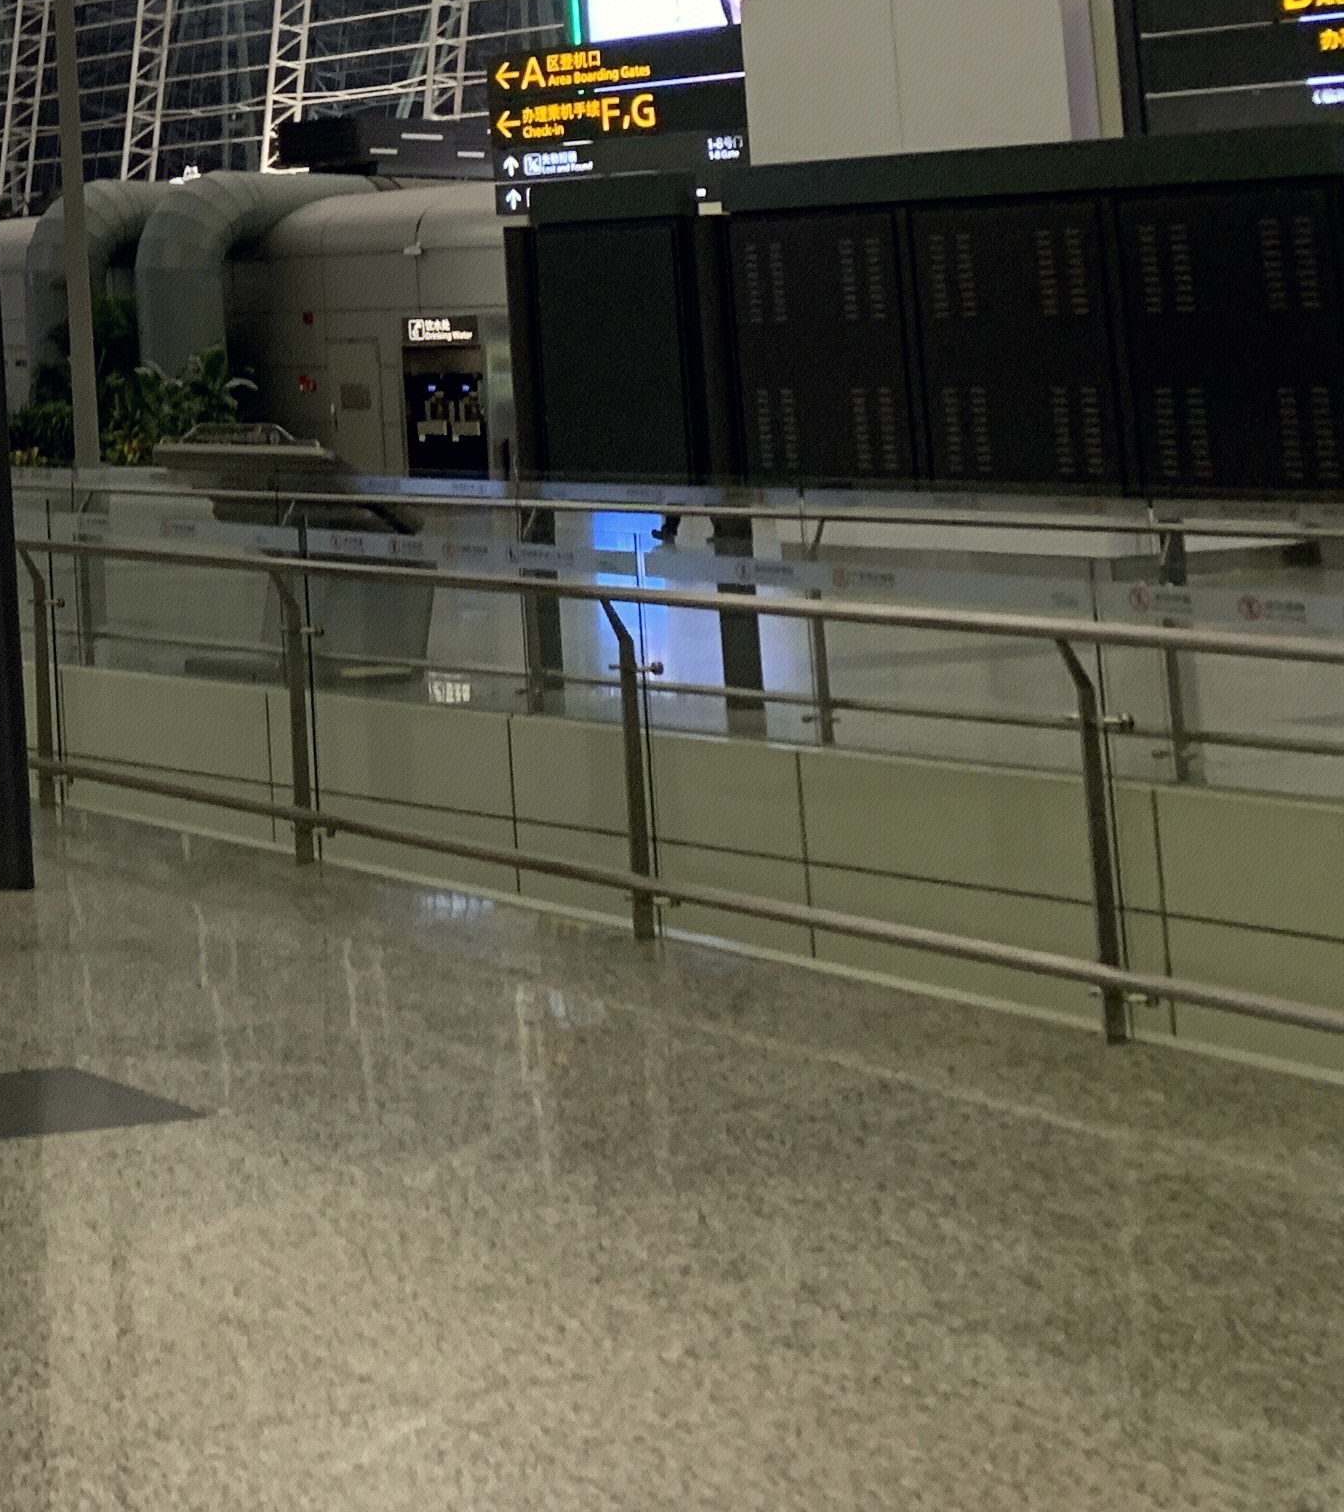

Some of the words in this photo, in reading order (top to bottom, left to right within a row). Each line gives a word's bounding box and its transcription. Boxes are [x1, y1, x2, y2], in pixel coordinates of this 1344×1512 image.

[547, 50, 601, 72] 区登机口
[521, 56, 546, 89] A
[548, 75, 572, 87] Area
[574, 68, 619, 84] Boarding
[621, 65, 651, 77] Gates
[522, 101, 601, 123] 办理乘机手续
[522, 124, 564, 139] Check-in
